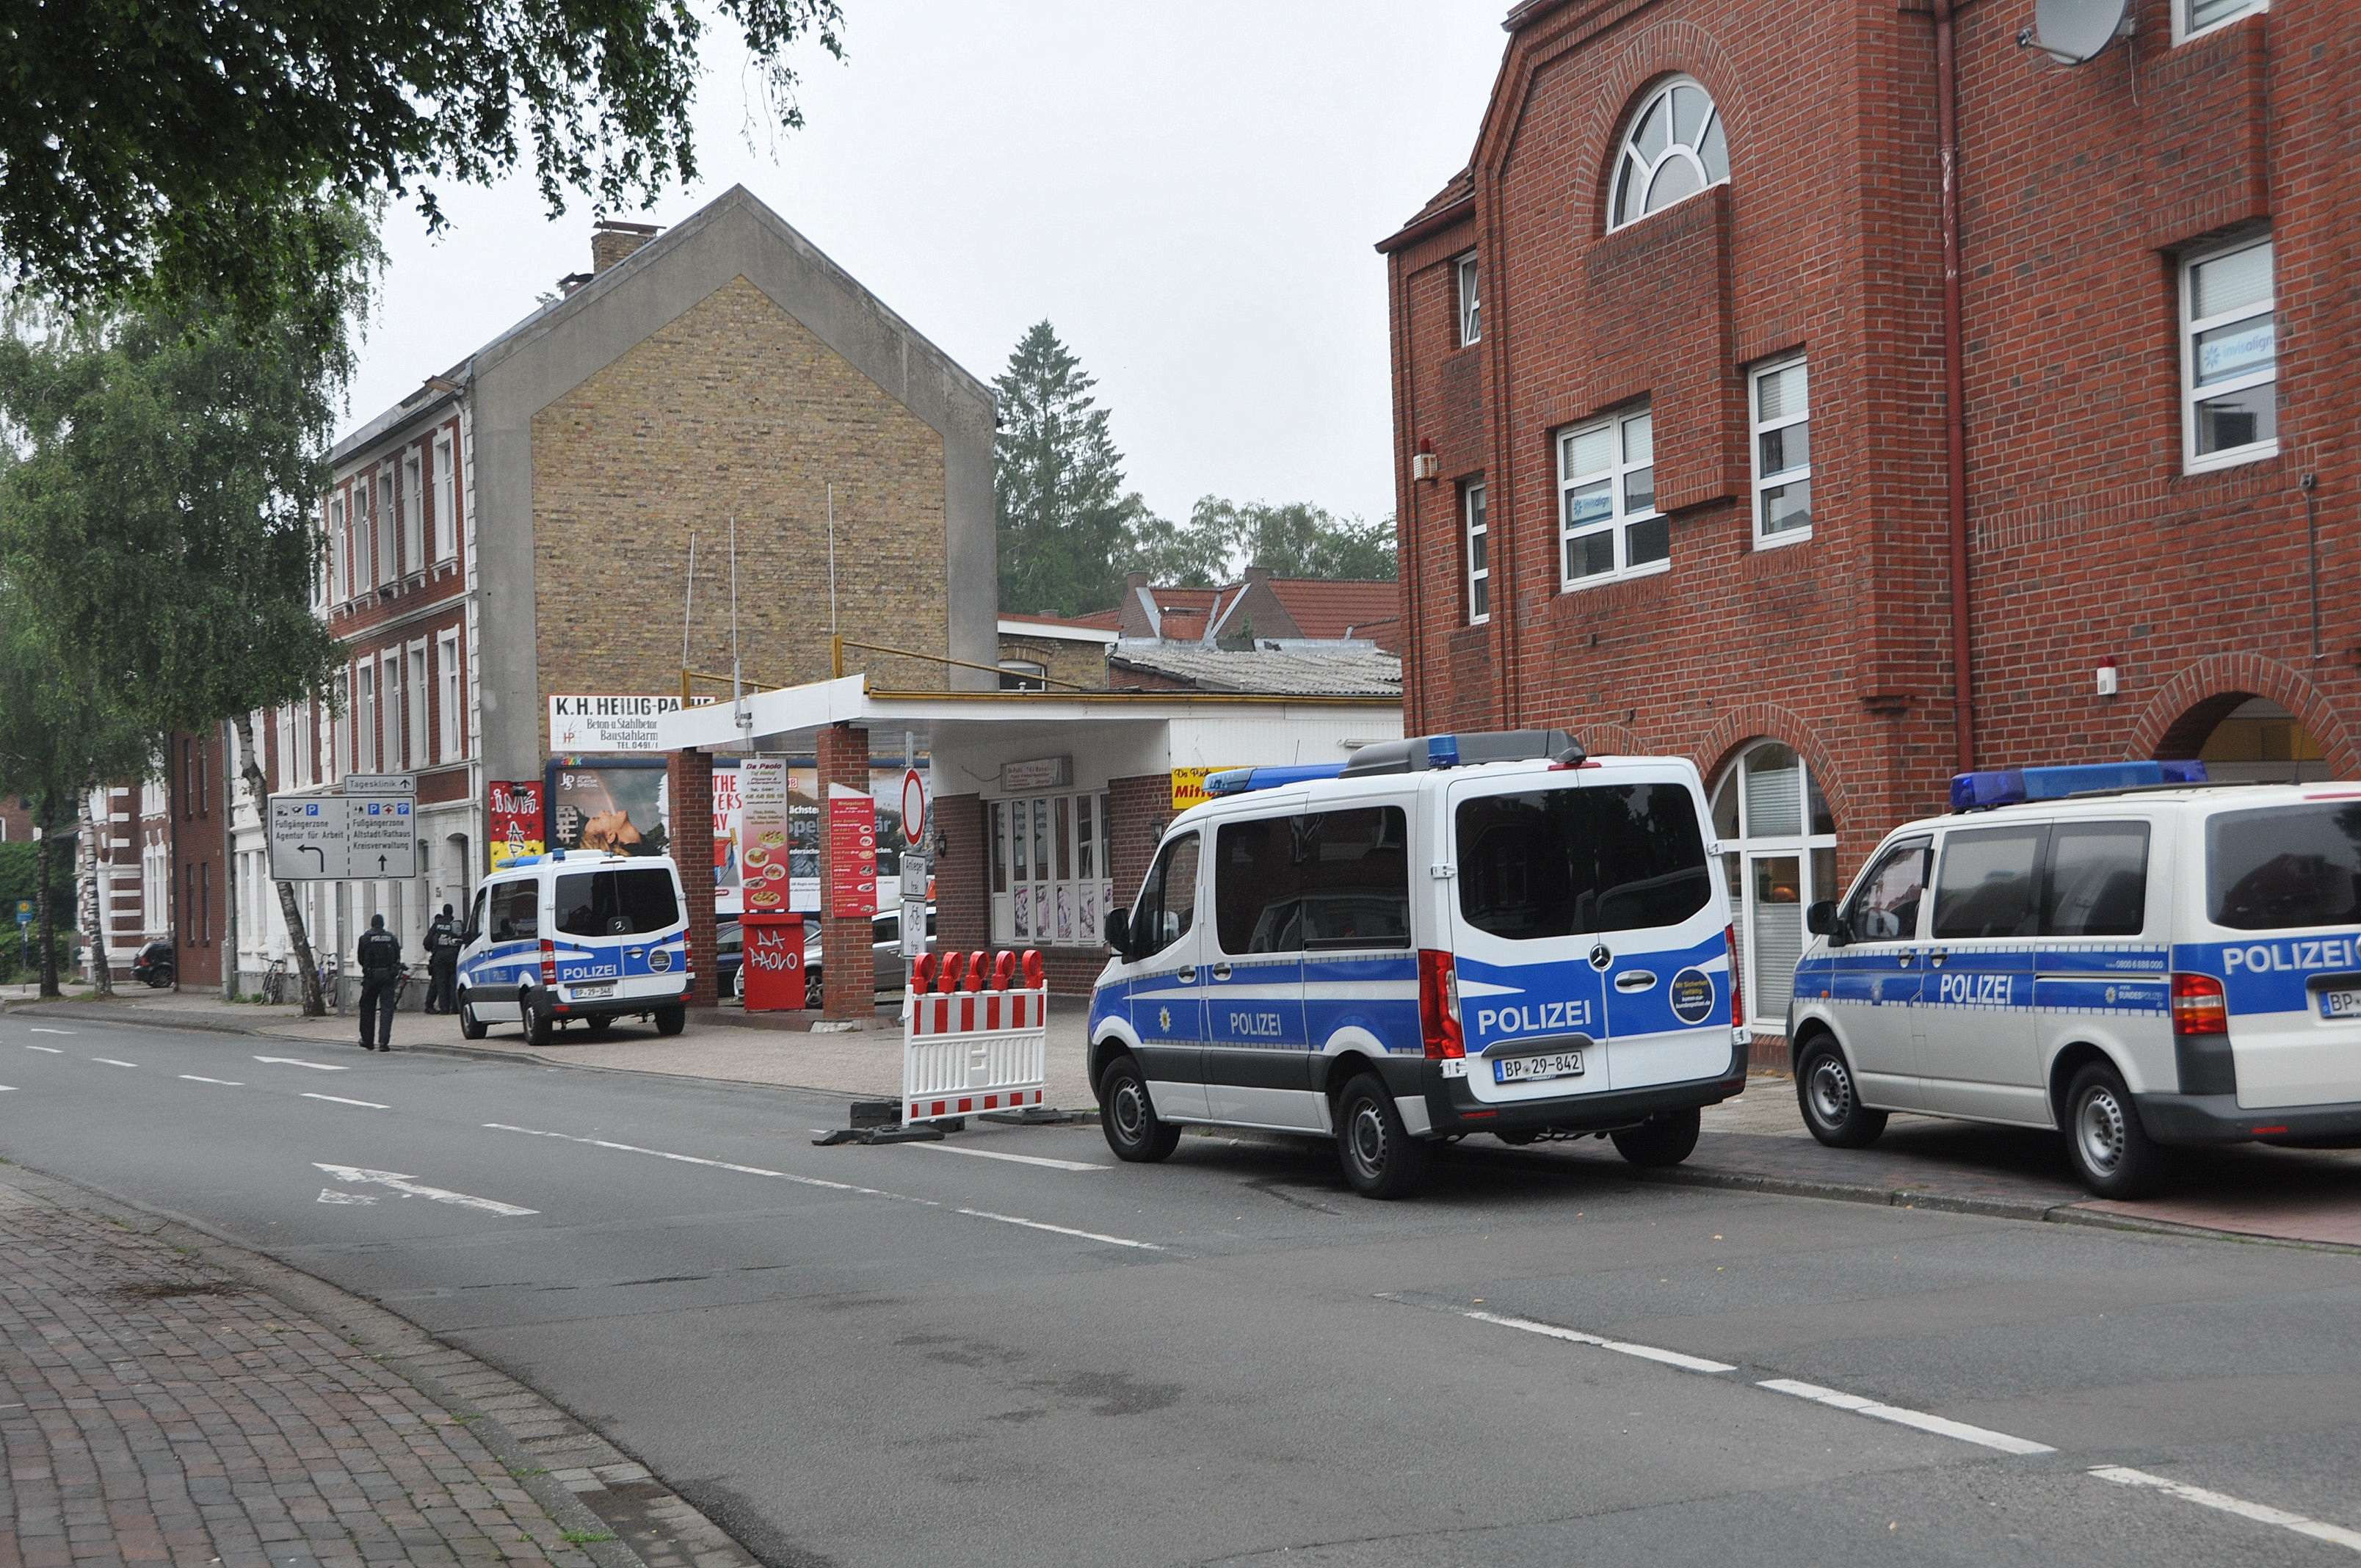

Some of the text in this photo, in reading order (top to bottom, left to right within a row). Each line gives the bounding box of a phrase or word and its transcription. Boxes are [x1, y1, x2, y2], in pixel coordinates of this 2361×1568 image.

[2223, 335, 2274, 357] invisalign
[587, 719, 609, 729] Beton
[350, 780, 396, 789] Tagesklinik
[712, 775, 736, 792] THE
[275, 819, 329, 830] Fußgängerzone
[276, 830, 344, 841] Agentur für Arbeit
[2222, 940, 2352, 975] POLIZEI
[563, 964, 617, 979] POLIZEI
[1940, 974, 2012, 1004] POLIZEI
[2330, 993, 2353, 1012] BP
[1230, 1012, 1282, 1036] POLIZEI
[1477, 999, 1592, 1035] POLIZEI
[1505, 1054, 1581, 1077] BP 29-842
